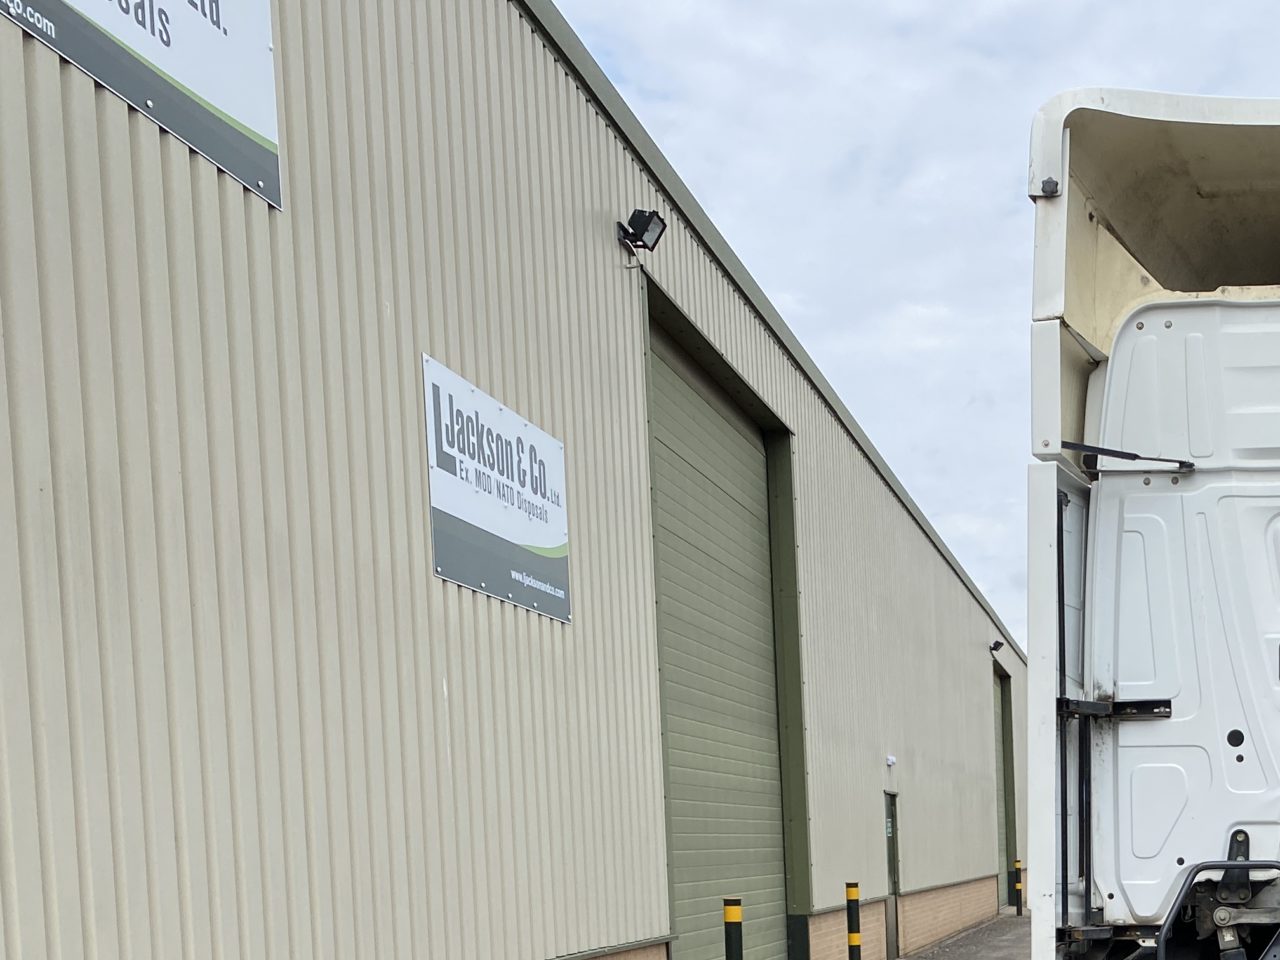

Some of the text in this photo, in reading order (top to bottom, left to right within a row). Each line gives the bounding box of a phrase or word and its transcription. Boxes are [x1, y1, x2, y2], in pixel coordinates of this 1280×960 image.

[459, 459, 473, 484] Ex.
[517, 490, 549, 524] Disposals
[516, 436, 527, 488] &
[529, 444, 550, 501] Co.
[550, 489, 562, 508] Ltd.
